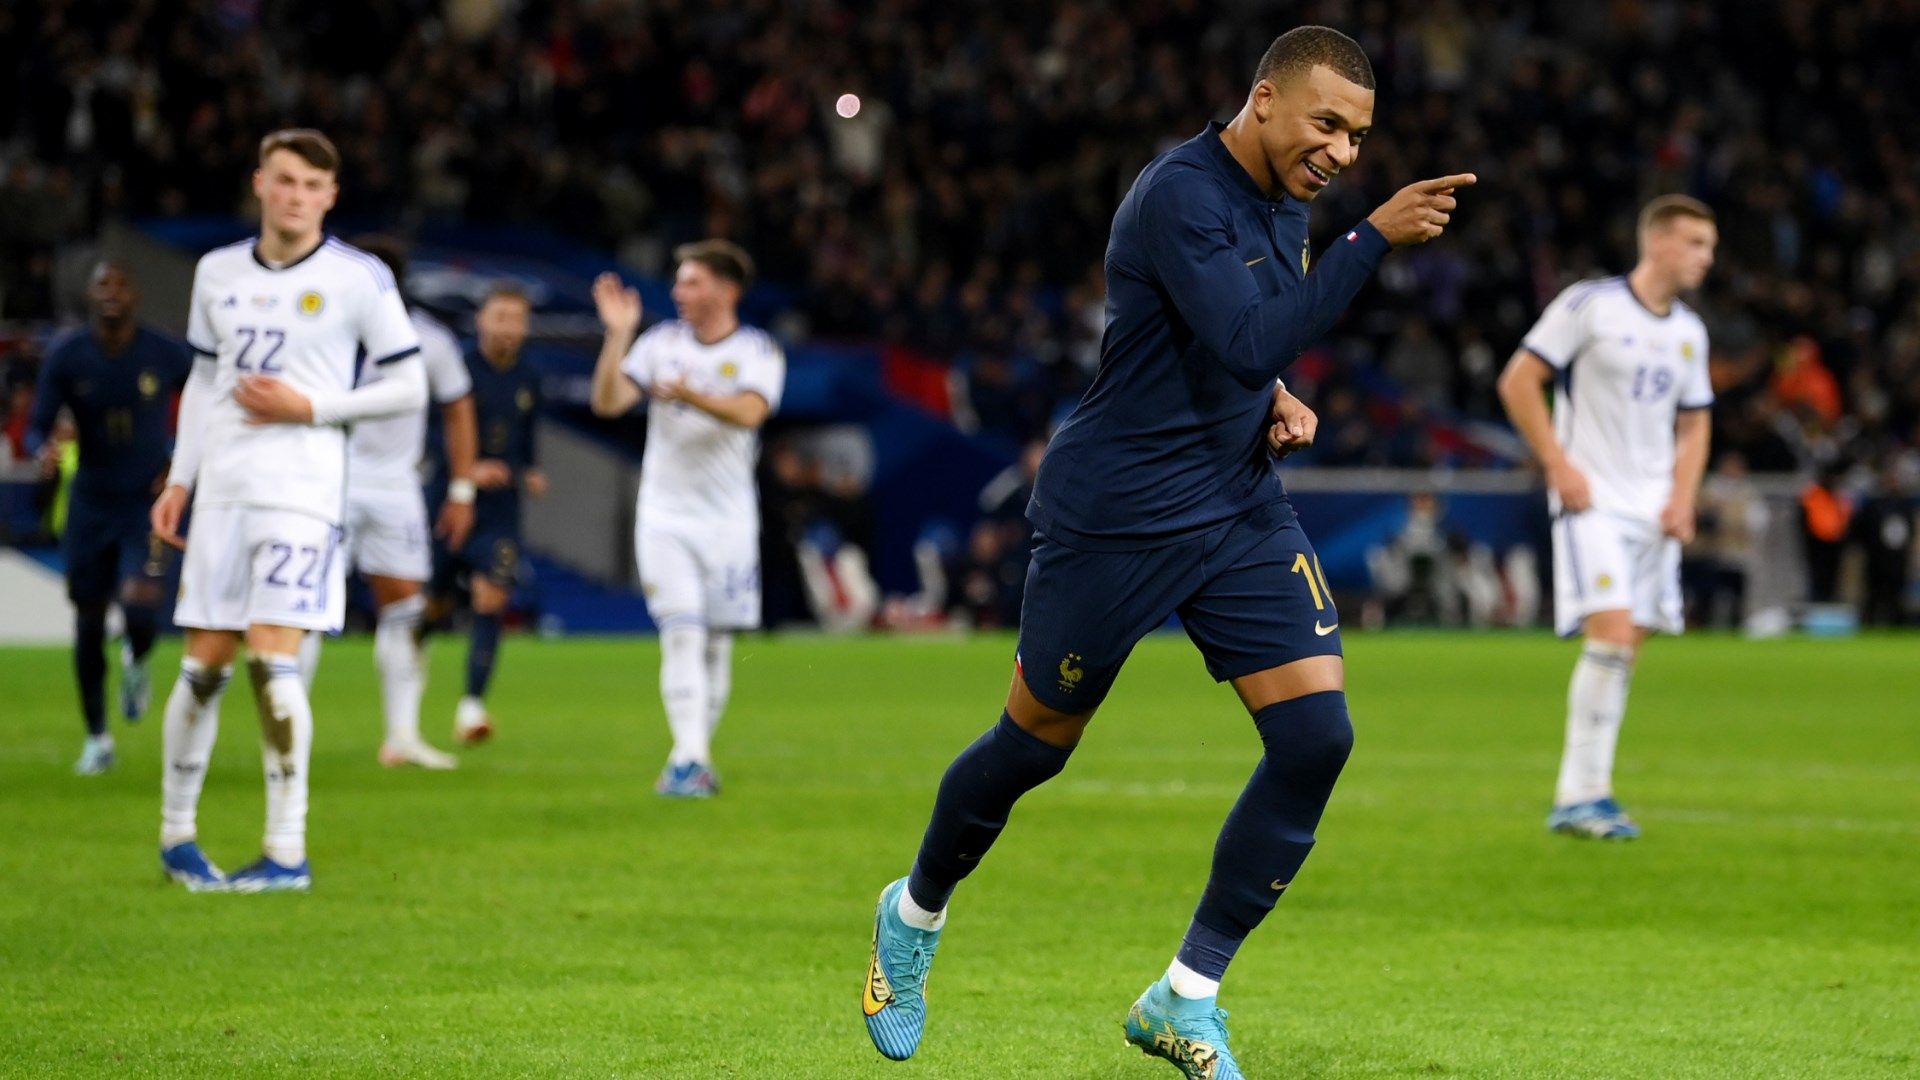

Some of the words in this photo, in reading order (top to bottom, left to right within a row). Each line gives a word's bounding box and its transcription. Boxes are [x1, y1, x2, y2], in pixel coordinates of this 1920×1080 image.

[235, 328, 286, 374] 22
[1632, 366, 1672, 404] 19
[265, 543, 319, 589] 22
